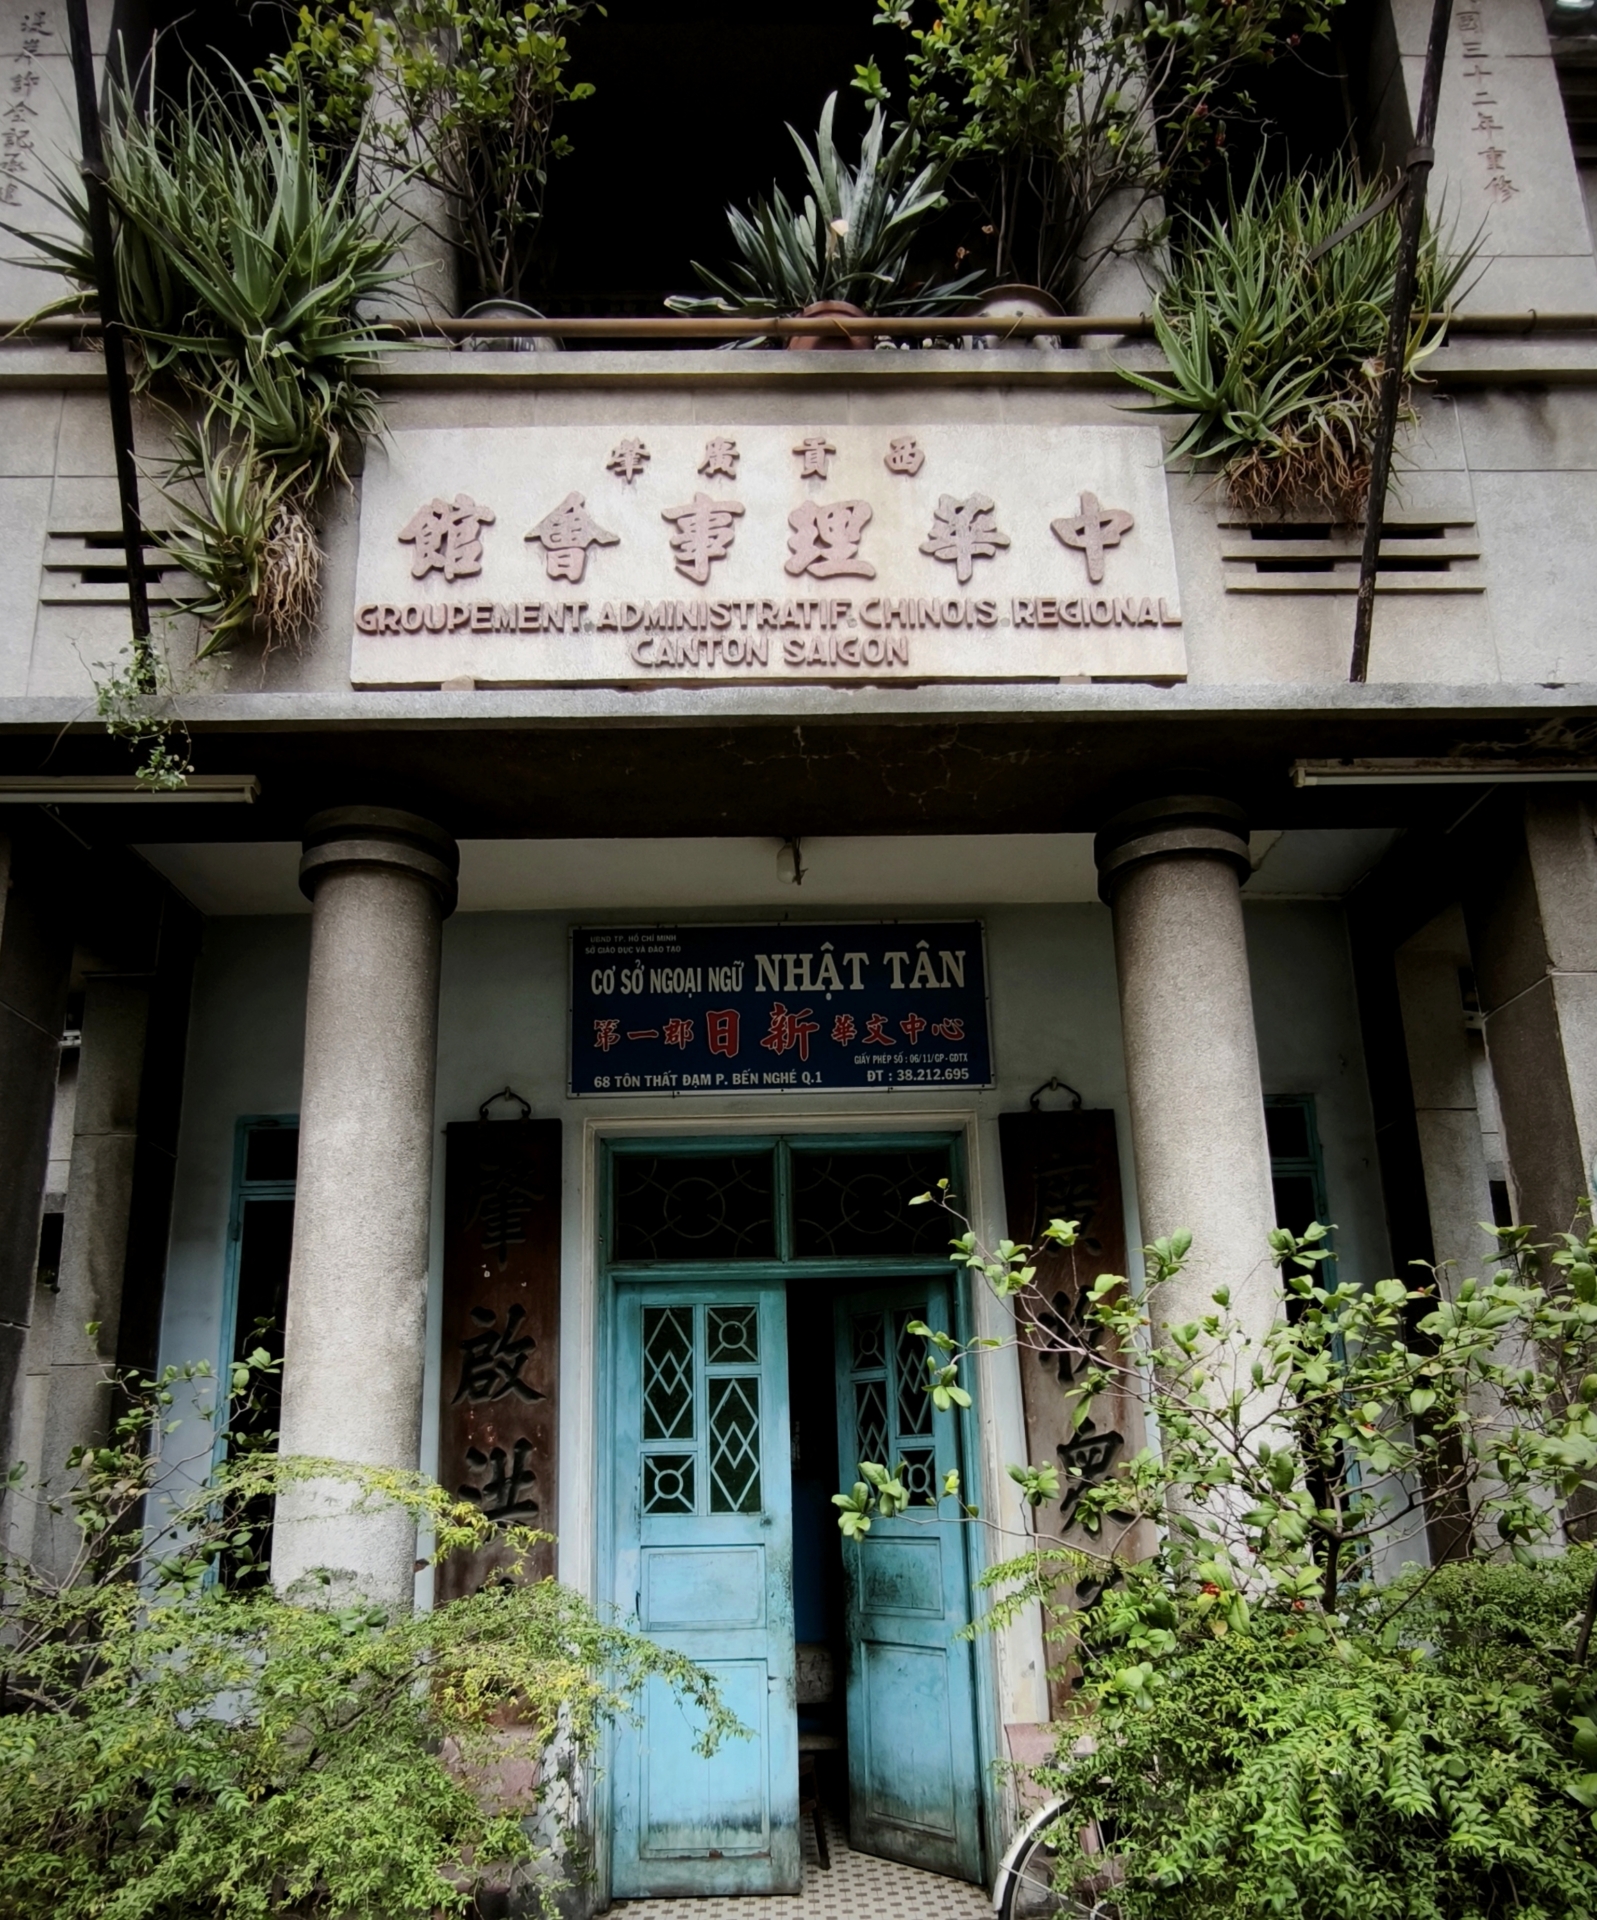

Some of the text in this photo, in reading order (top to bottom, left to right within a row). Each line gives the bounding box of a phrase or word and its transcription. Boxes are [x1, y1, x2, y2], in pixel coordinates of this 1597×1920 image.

[1456, 0, 1520, 204] 國三十二年重修
[398, 490, 1135, 584] 中華理事會館
[1011, 597, 1182, 627] REGIONAL
[630, 635, 908, 667] CANTON SAIGON
[656, 934, 677, 942] MINH
[591, 939, 966, 1000] CƠ SỞ NGOẠI NGỮ NHẬT TÂN
[594, 1069, 822, 1088] 68 TÔN THẤT ĐẠM P. BẾN NGHÉ Q.1
[896, 1067, 969, 1081] 38.212.695
[451, 1152, 547, 1600] 肇啟洪
